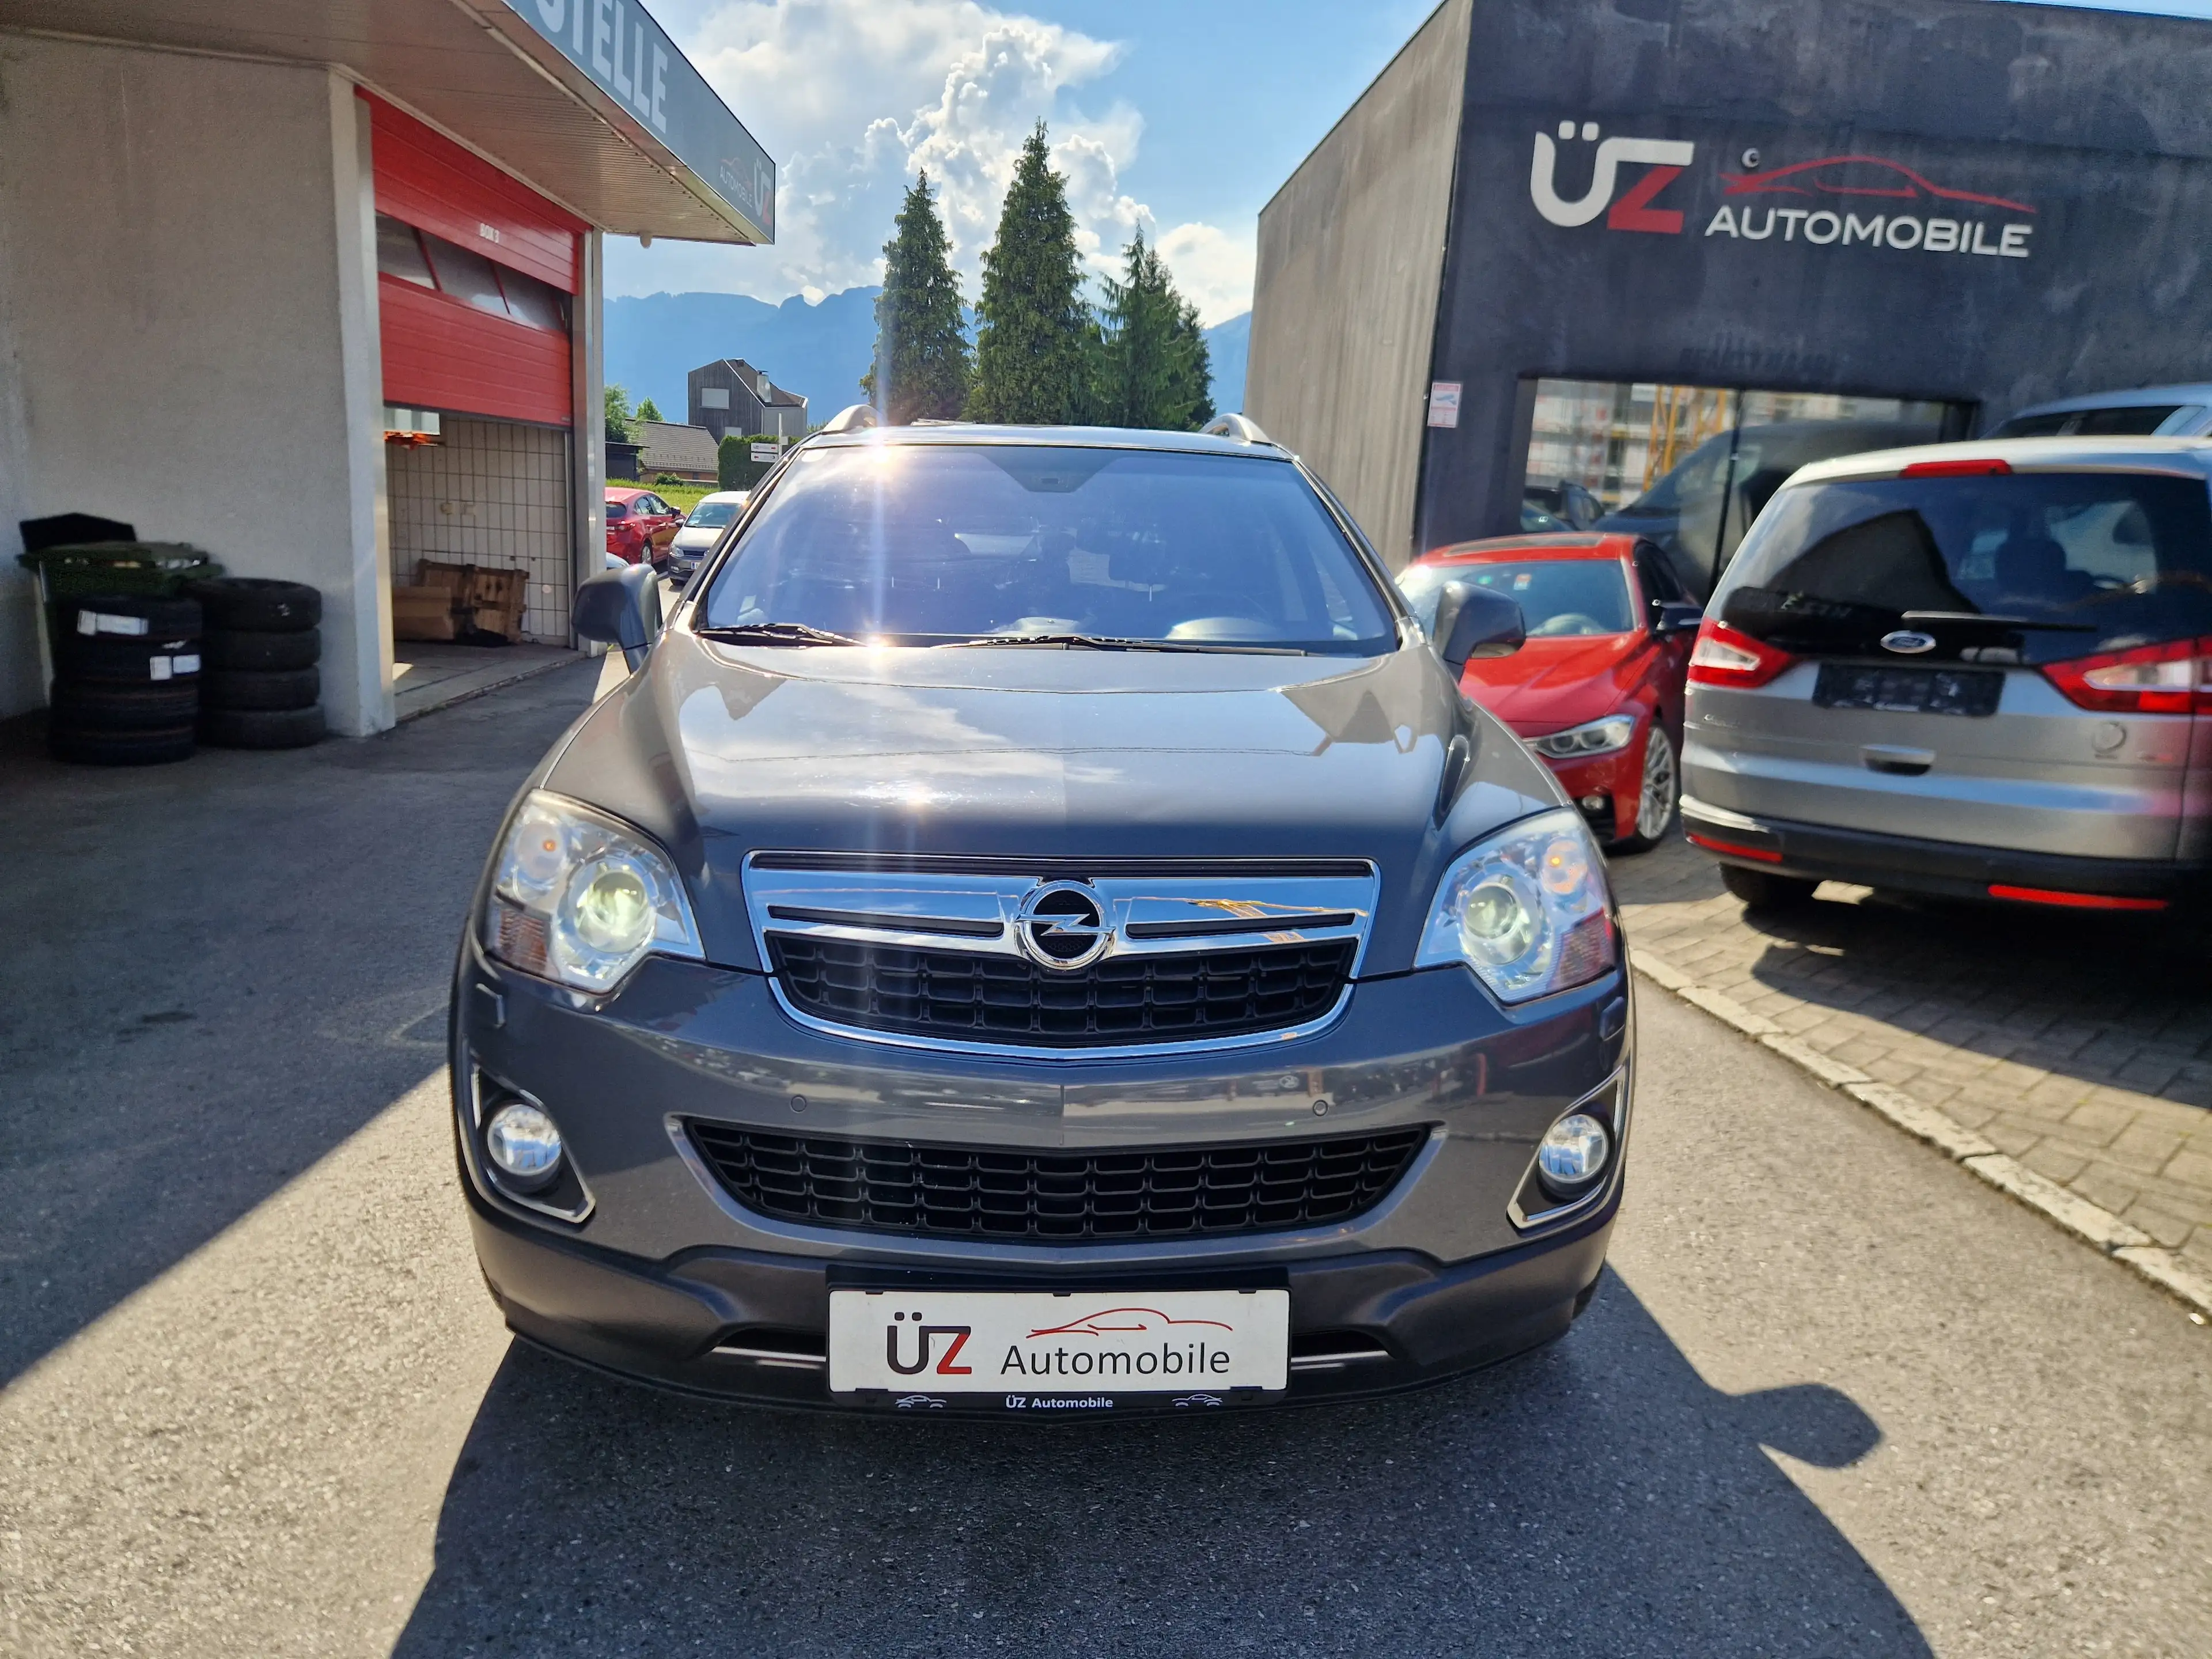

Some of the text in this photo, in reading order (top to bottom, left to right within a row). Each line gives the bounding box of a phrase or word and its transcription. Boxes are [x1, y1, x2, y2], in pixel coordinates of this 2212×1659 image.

[720, 165, 753, 208] AUTOMOBILE
[1530, 120, 1695, 234] ÜZ
[1705, 204, 2033, 257] AUTOMOBILE
[887, 1312, 1230, 1375] ÜZ Automobile
[1005, 1395, 1113, 1408] ÜZ Automobile
